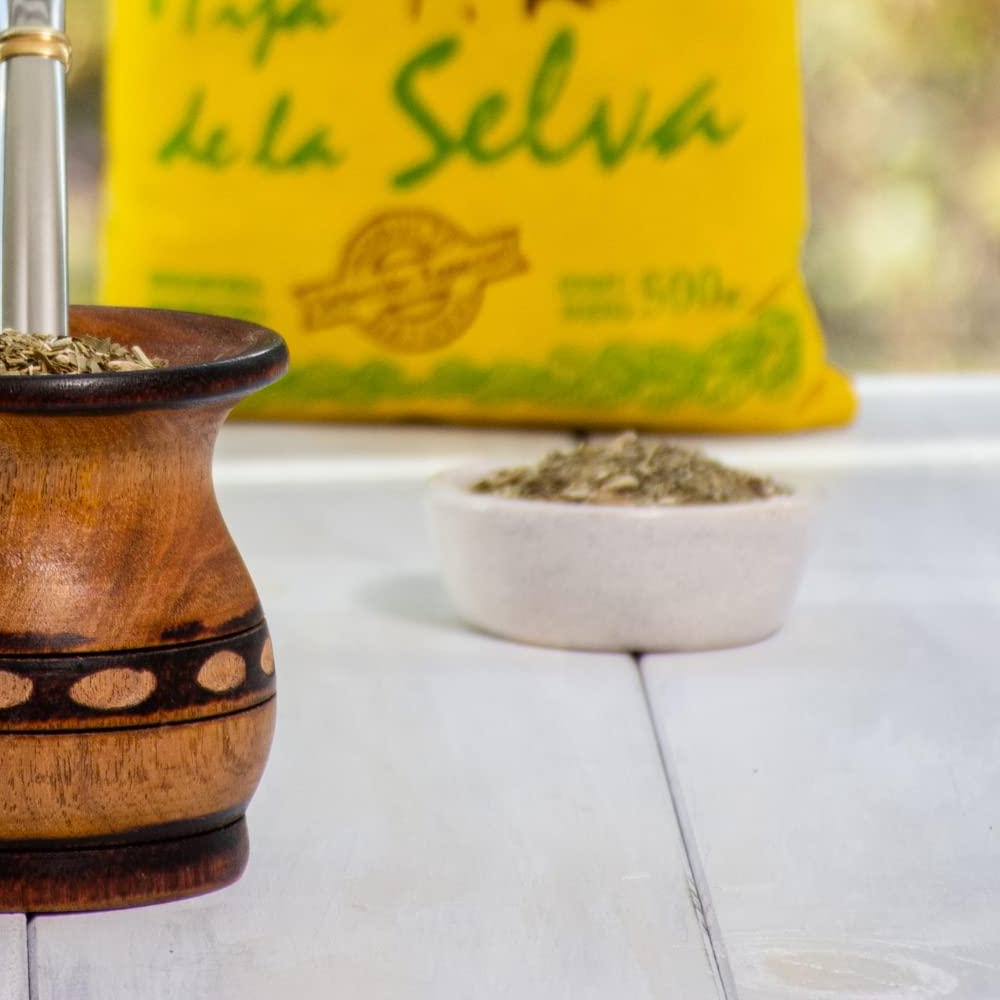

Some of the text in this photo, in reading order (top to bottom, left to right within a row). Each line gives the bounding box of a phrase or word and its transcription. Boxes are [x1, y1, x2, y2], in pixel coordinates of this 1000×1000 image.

[158, 27, 740, 190] de la Selva
